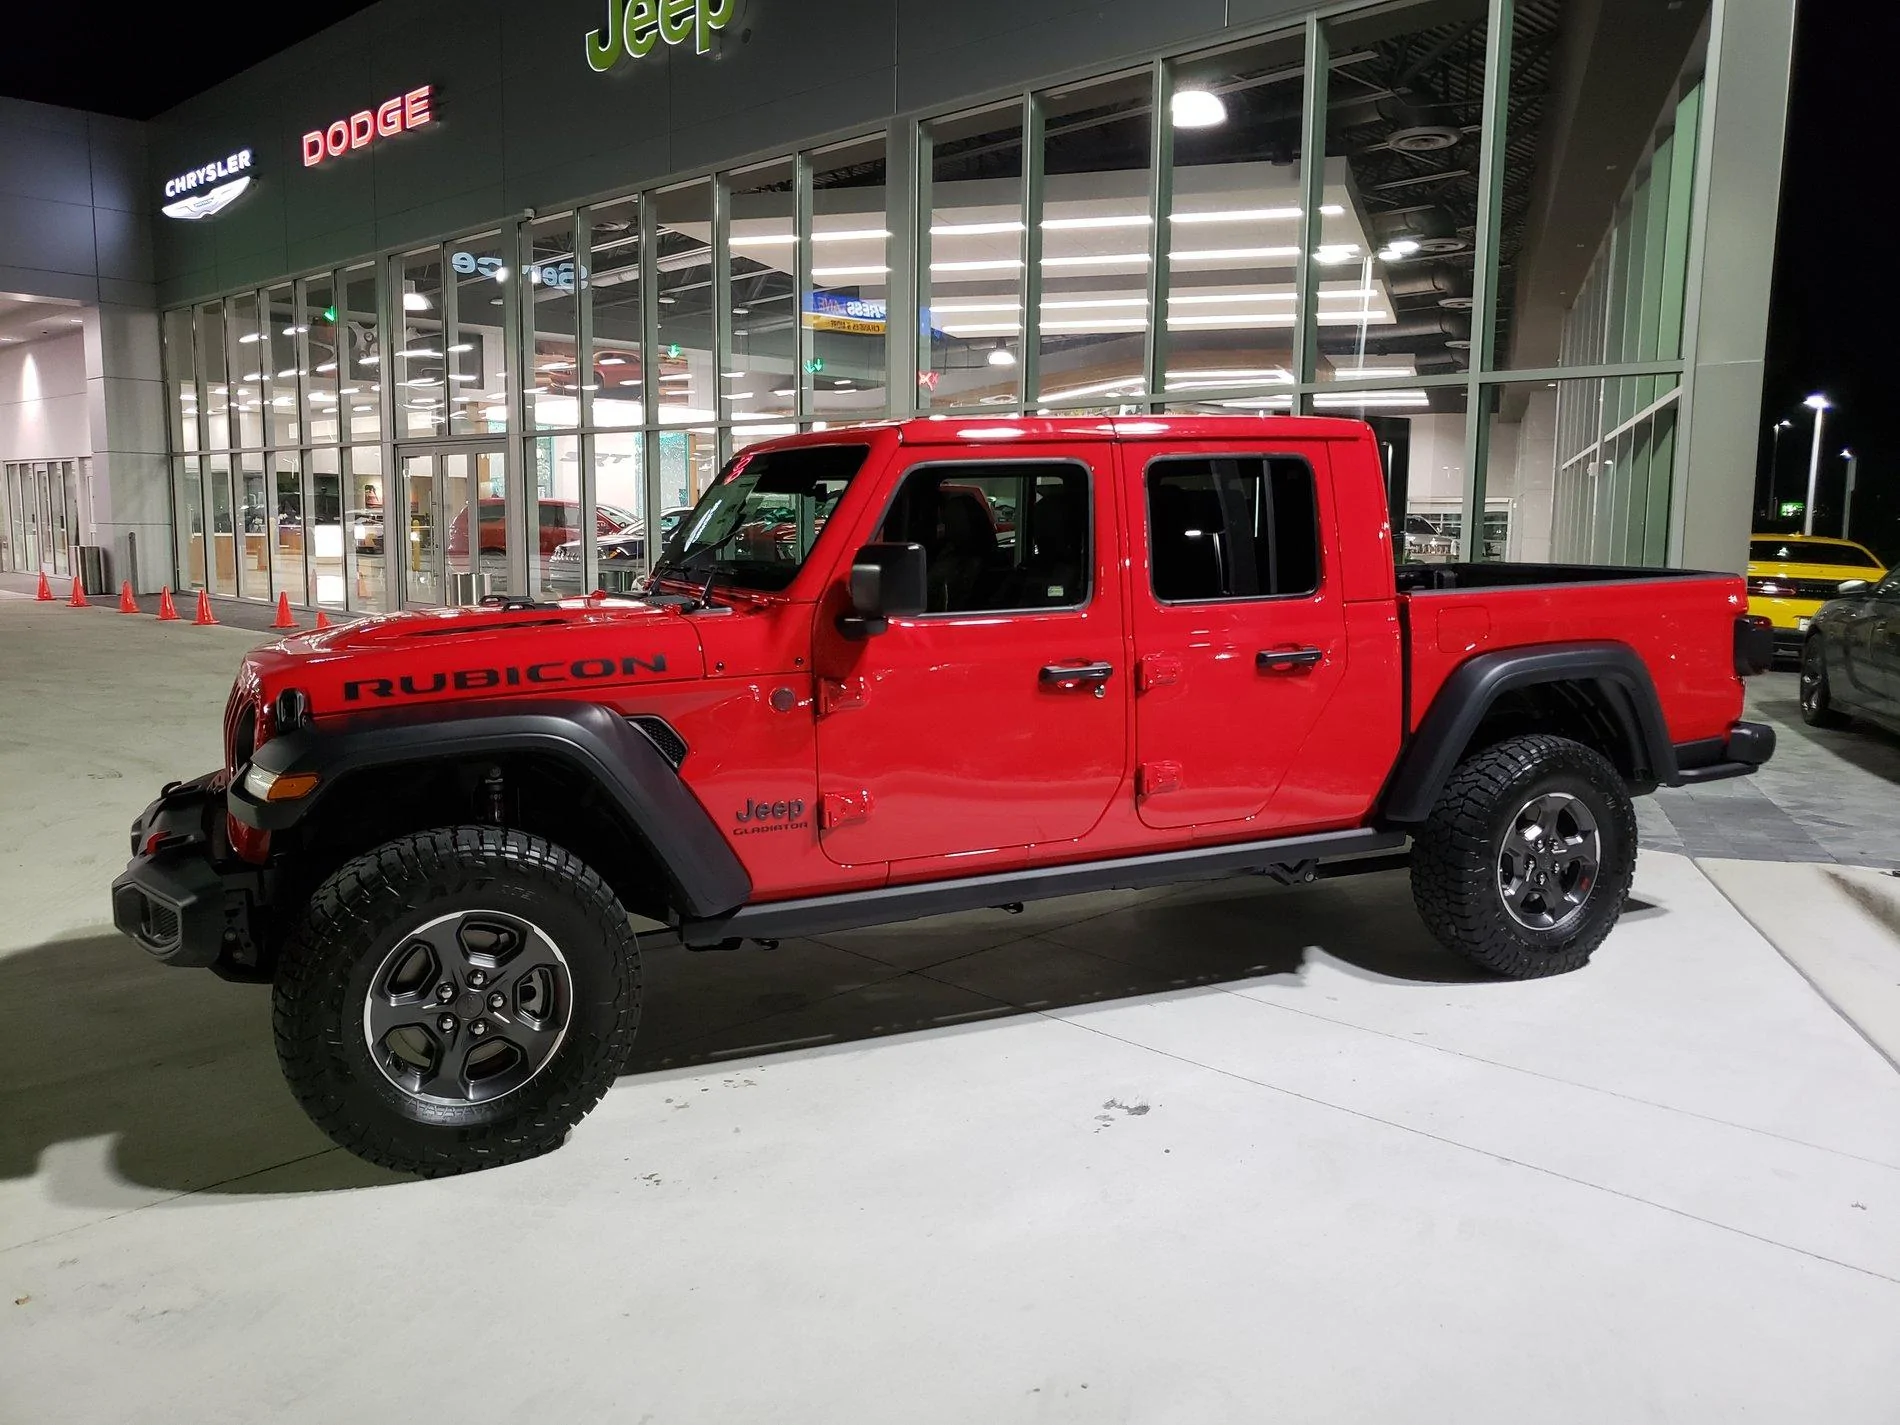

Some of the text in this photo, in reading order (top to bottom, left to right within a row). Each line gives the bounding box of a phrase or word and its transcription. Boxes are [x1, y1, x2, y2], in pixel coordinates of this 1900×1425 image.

[585, 0, 735, 72] Jeep
[303, 85, 431, 167] DODGE
[165, 149, 251, 198] CHRYSLER
[344, 653, 667, 700] RUBICON
[733, 822, 808, 836] GLADIATOR
[736, 798, 805, 822] Jeep
